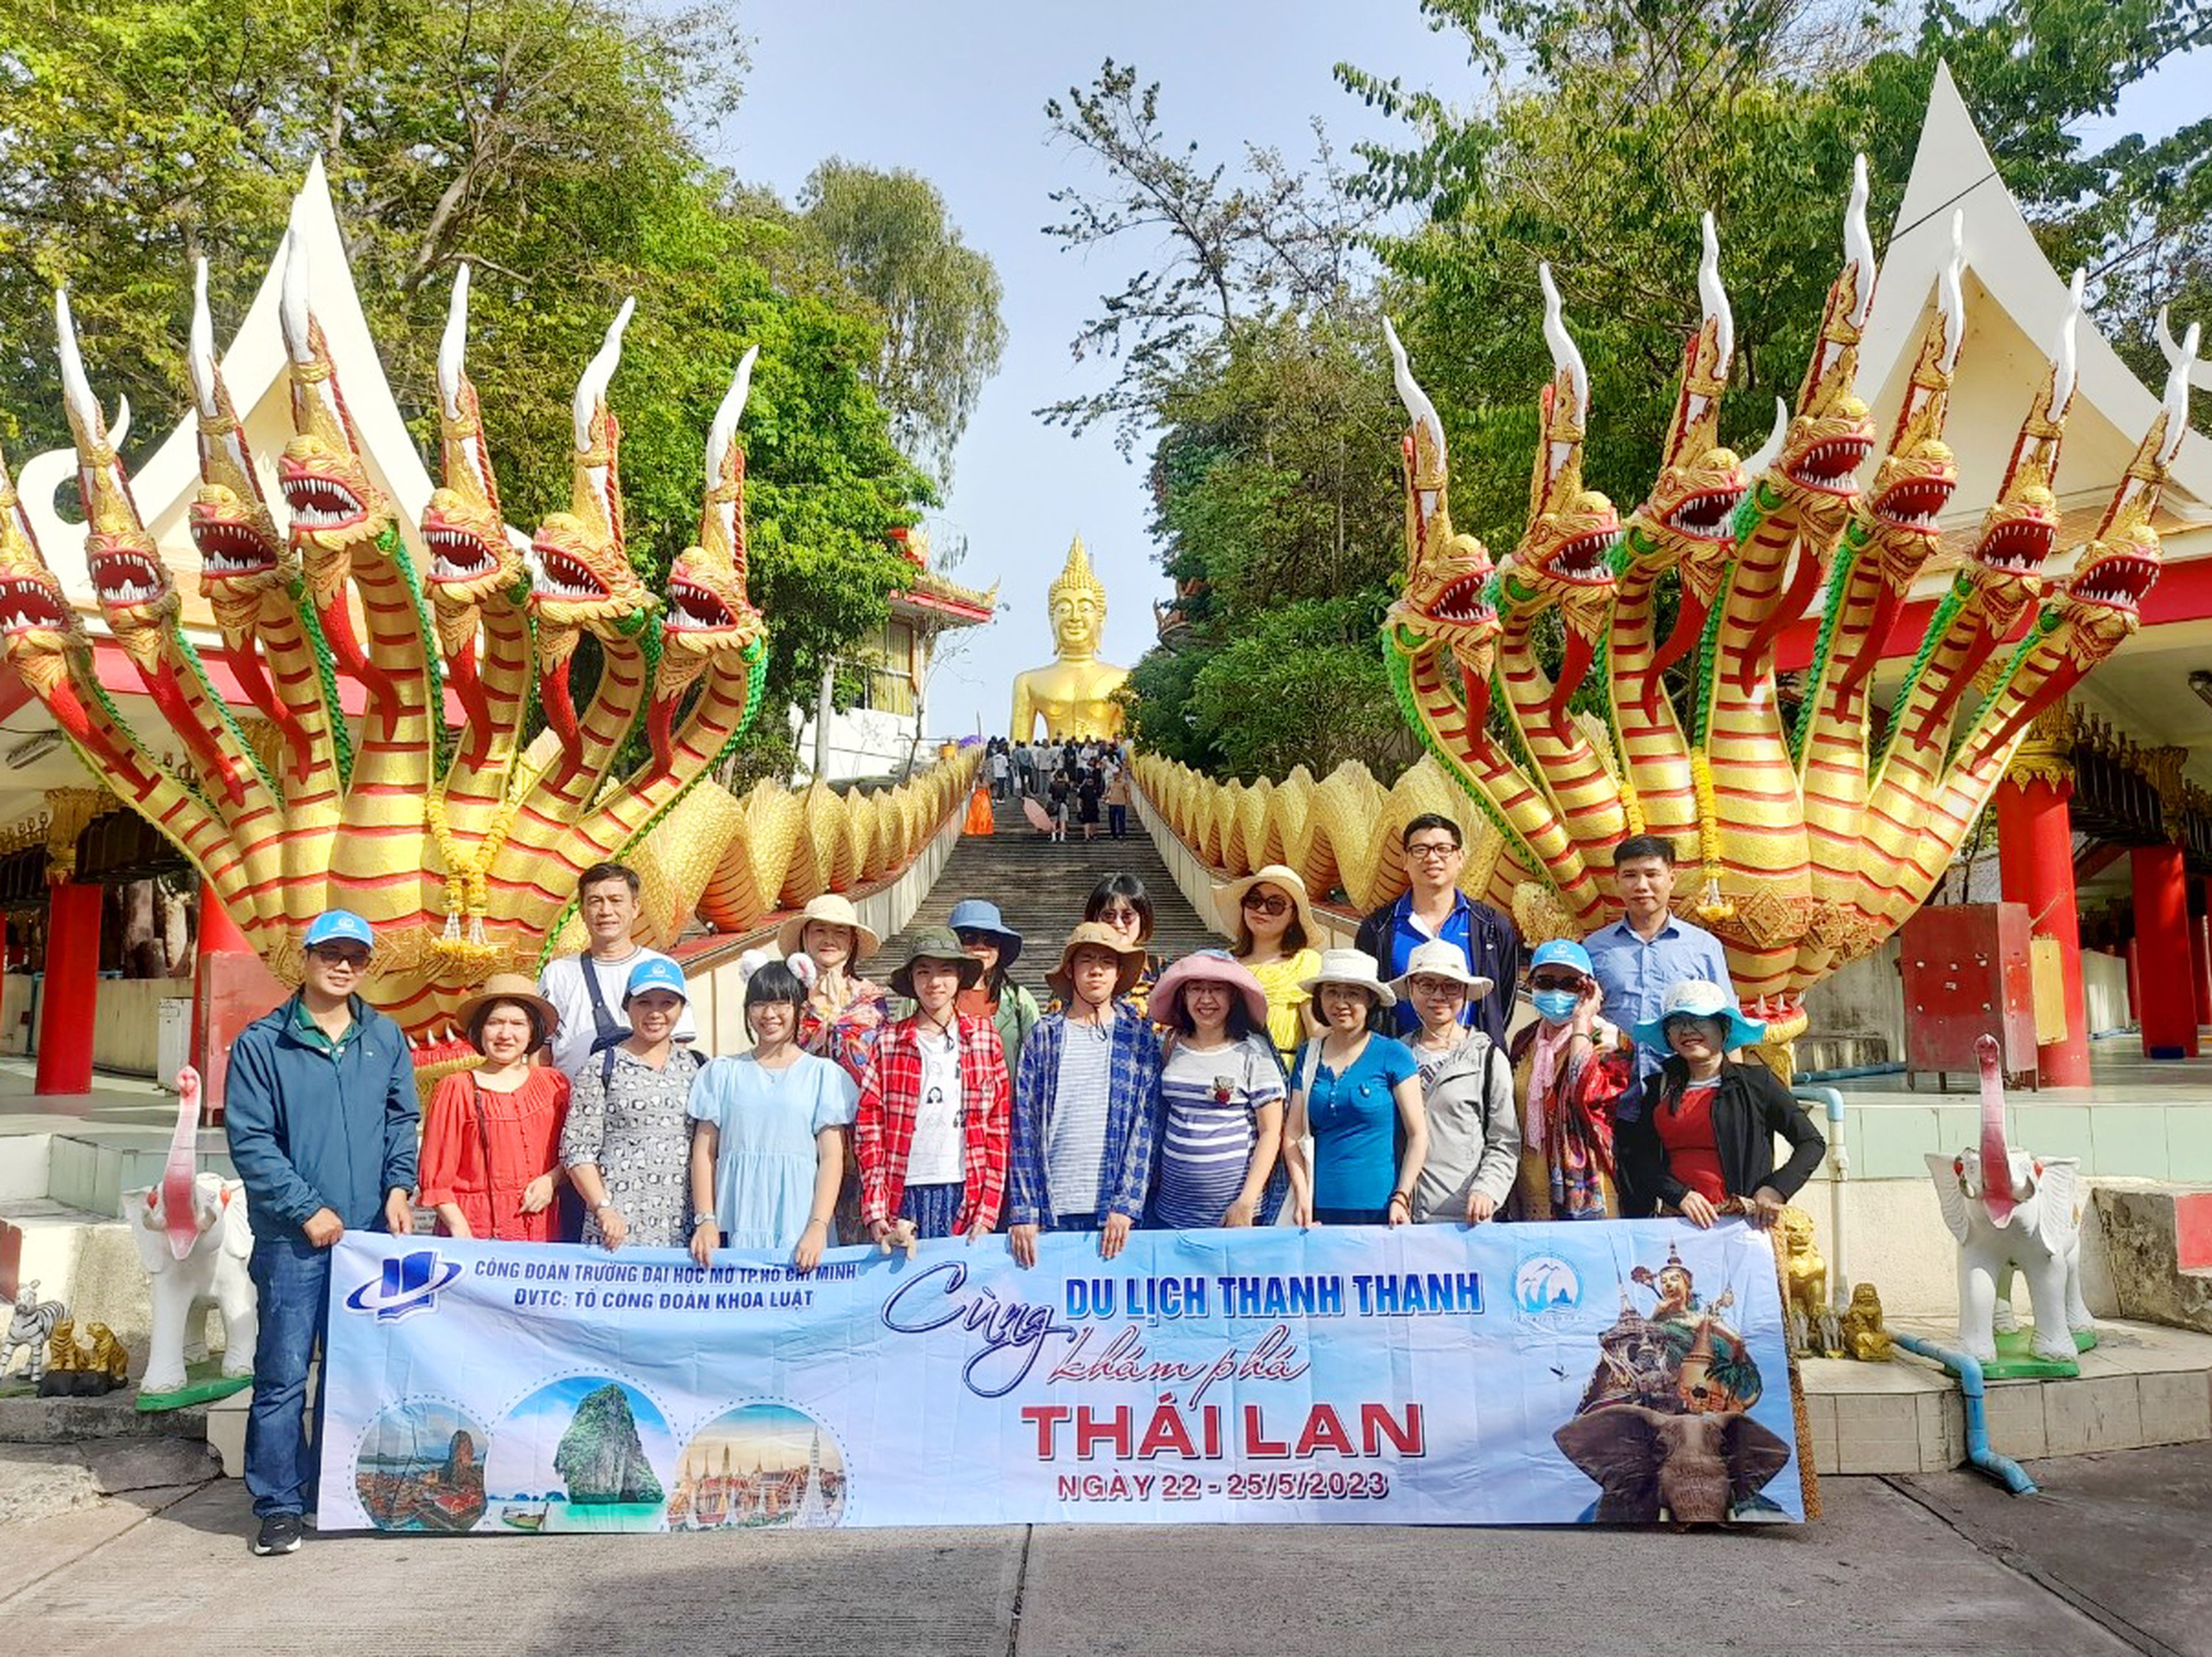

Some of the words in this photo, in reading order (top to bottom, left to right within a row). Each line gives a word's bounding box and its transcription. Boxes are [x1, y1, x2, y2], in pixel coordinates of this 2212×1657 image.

[475, 1257, 520, 1278] CÔNG
[525, 1261, 570, 1281] ĐOÀN
[575, 1262, 638, 1283] TRƯỜNG
[642, 1266, 669, 1287] ĐẠI
[673, 1268, 704, 1287] HỌC
[709, 1264, 736, 1284] MỞ
[815, 1264, 857, 1281] MINH
[514, 1288, 568, 1306] ĐVTC:
[574, 1285, 599, 1308] TỔ
[603, 1289, 653, 1310] CÔNG
[659, 1291, 710, 1310] ĐOÀN
[715, 1292, 764, 1309] KHOA
[770, 1288, 813, 1311] LUẬT
[1066, 1278, 1117, 1319] DU
[1126, 1277, 1209, 1328] LỊCH
[1217, 1276, 1346, 1318] THANH
[1353, 1272, 1486, 1316] THANH
[881, 1261, 1077, 1398] Cùng
[1047, 1325, 1207, 1386] khám
[1189, 1325, 1310, 1411] phá
[1021, 1391, 1222, 1459] THÁI
[1244, 1403, 1427, 1458] LAN
[1058, 1469, 1154, 1501] NGÀY
[1162, 1475, 1202, 1500] 22
[1226, 1471, 1390, 1499] 25/5/2023
